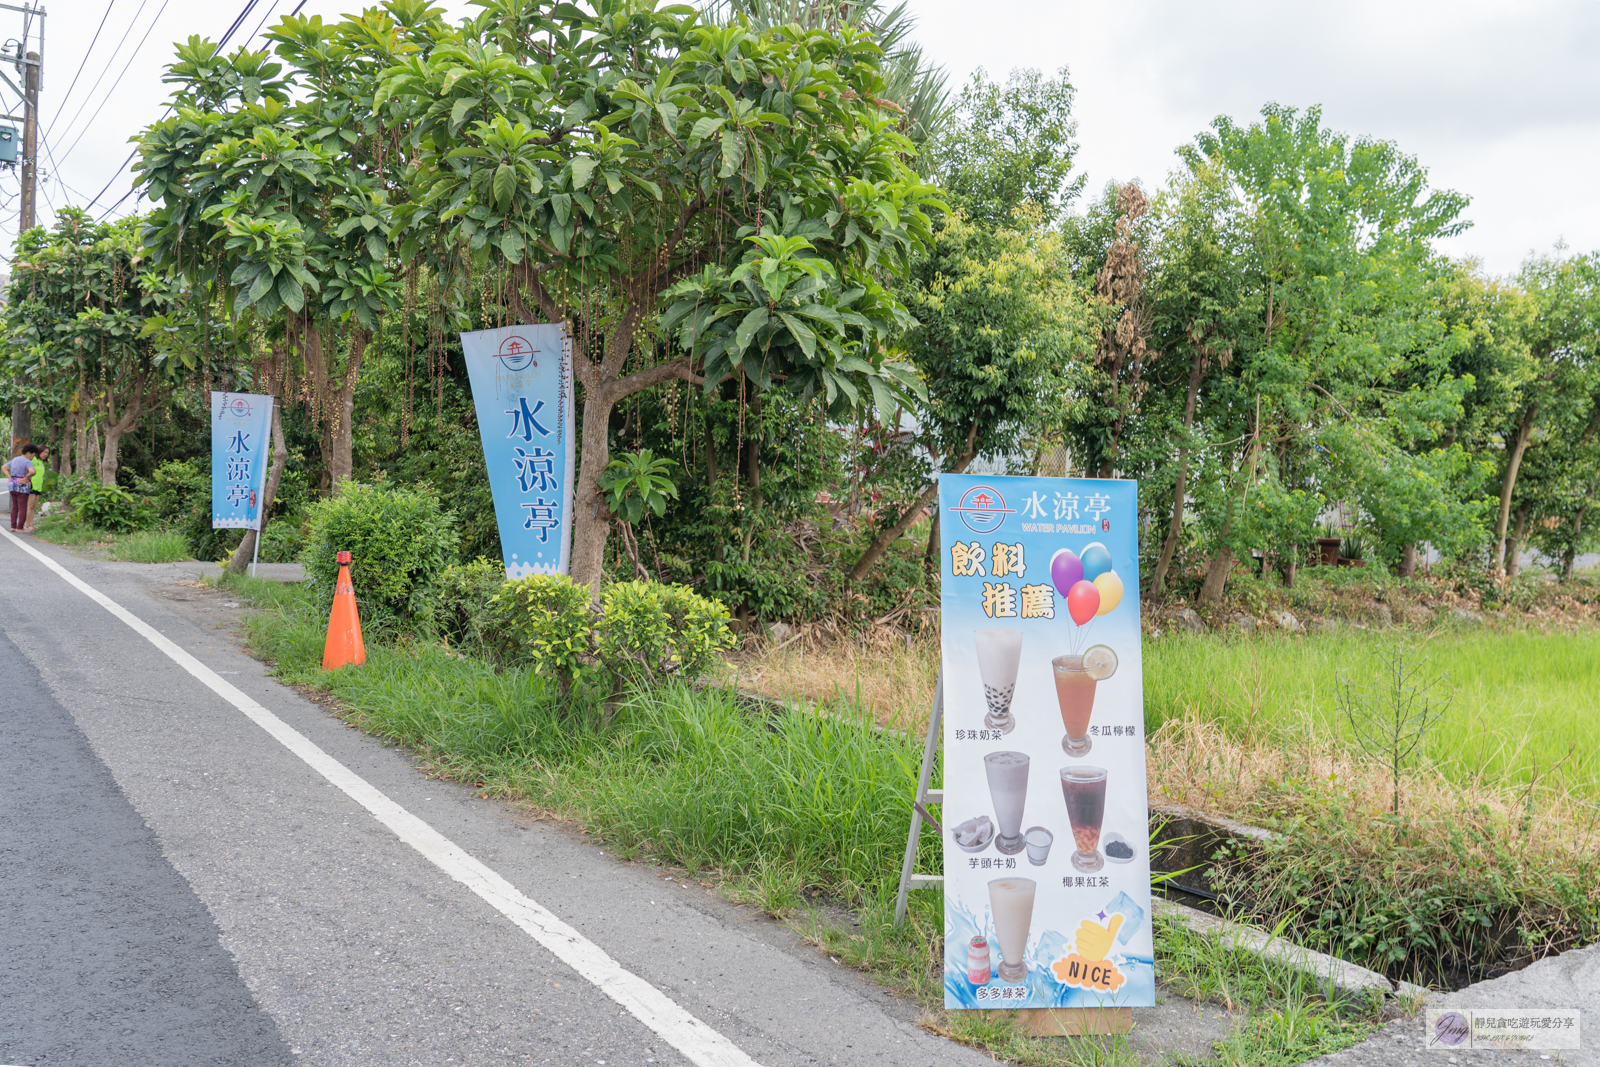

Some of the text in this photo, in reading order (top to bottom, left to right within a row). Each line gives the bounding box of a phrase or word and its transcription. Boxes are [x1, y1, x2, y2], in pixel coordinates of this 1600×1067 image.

[225, 430, 251, 508] 水涼亭
[503, 396, 560, 544] 水涼亭
[1021, 490, 1111, 522] 水涼亭
[1021, 522, 1096, 534] WATER PAVILION
[950, 540, 1027, 578] 飲料
[982, 582, 1054, 619] 推薦
[955, 729, 1002, 741] 珍珠奶茶
[1089, 725, 1136, 737] 冬瓜檸檬
[968, 857, 1017, 869] 芋頭牛奶
[1062, 876, 1110, 888] 椰果紅茶
[1068, 961, 1112, 985] NICE
[977, 986, 1027, 999] 多多綠茶
